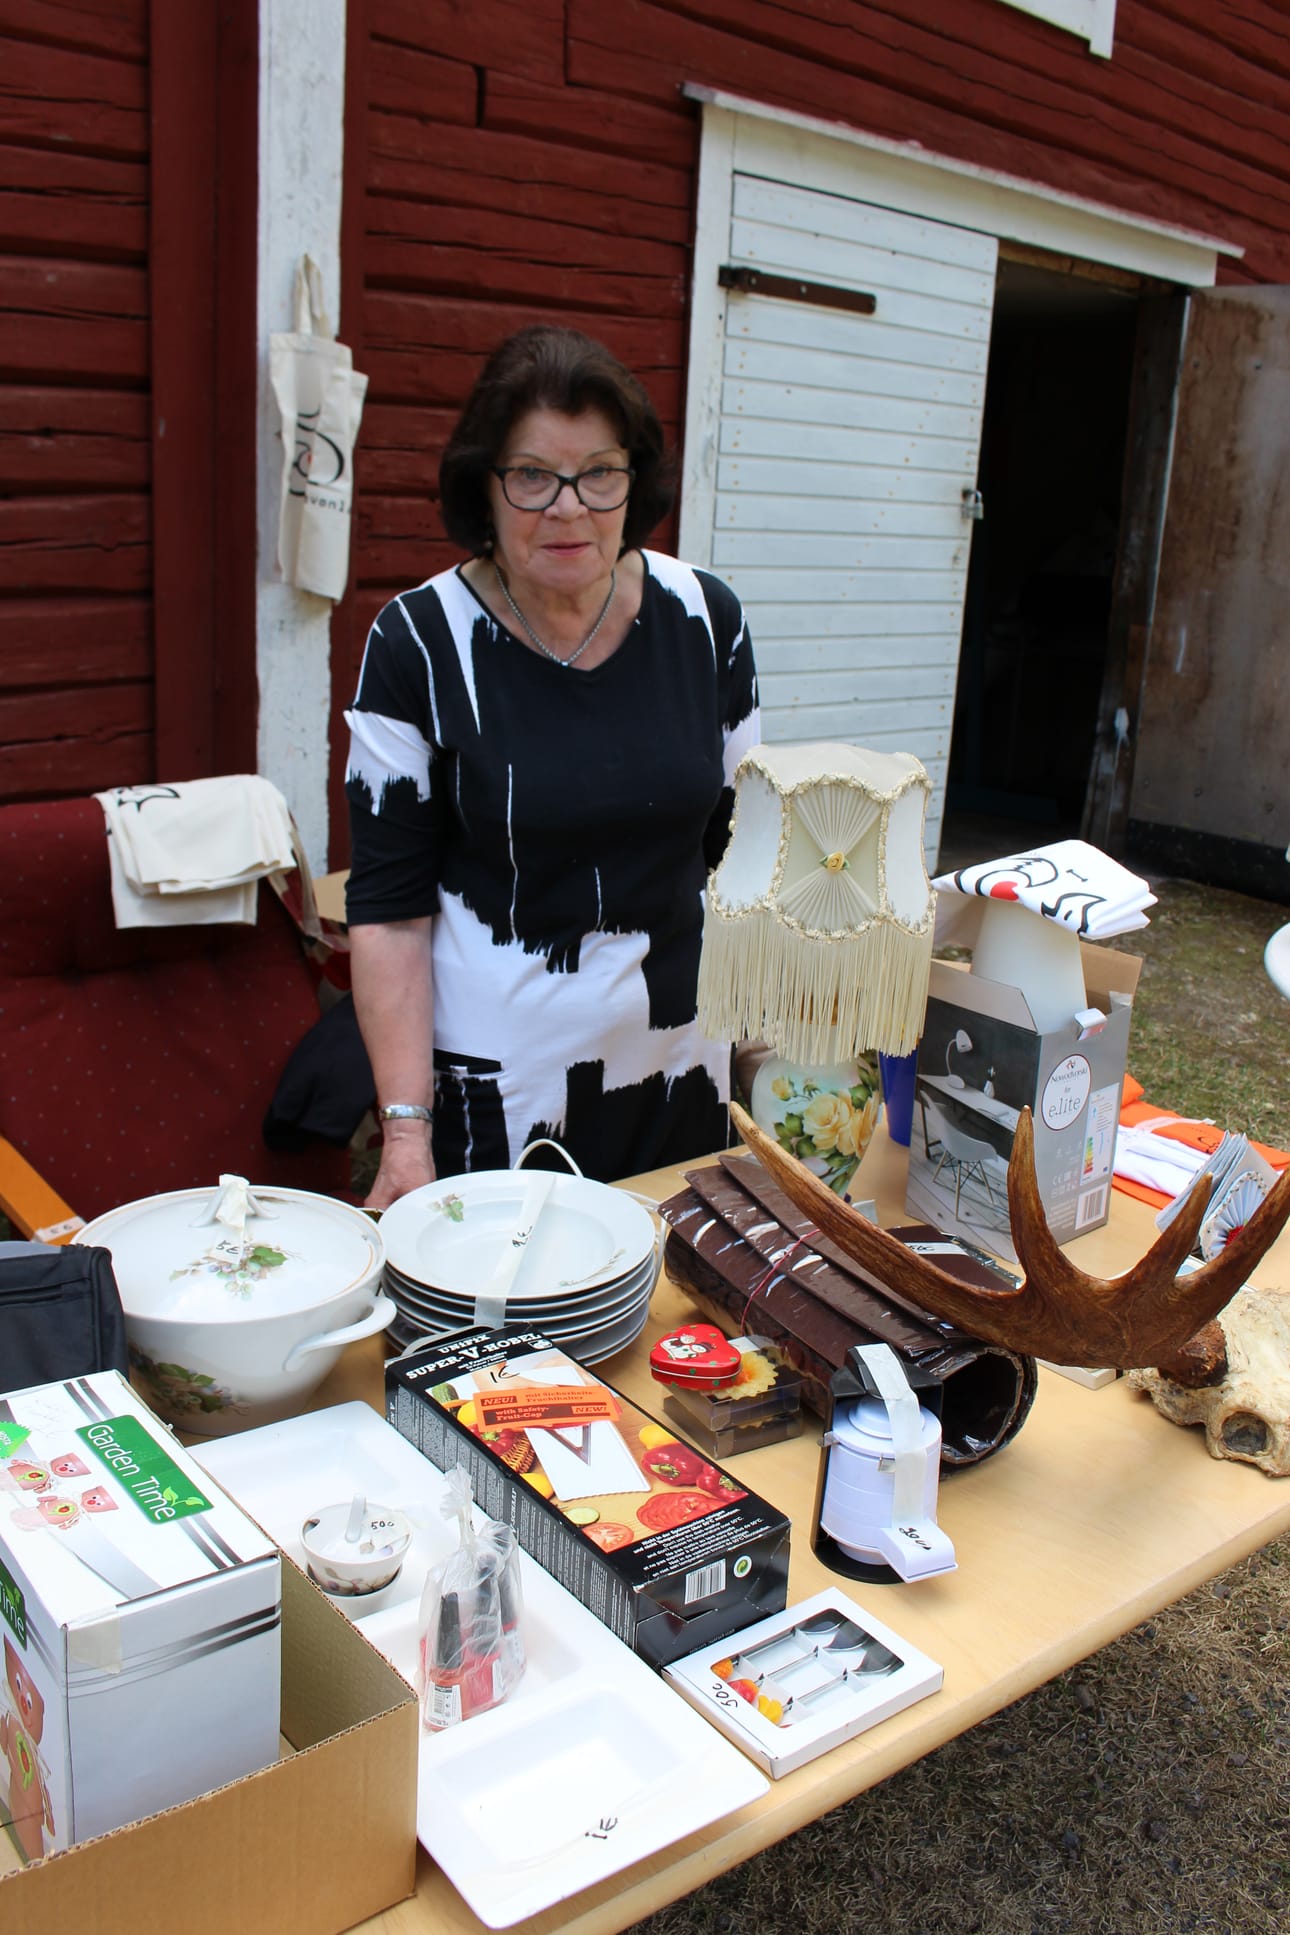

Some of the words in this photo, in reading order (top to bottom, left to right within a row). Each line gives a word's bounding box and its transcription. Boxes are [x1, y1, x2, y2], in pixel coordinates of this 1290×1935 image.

[405, 1332, 542, 1380] SUPER-V-HOBEL
[483, 1396, 513, 1406] NEU!
[495, 1408, 516, 1416] with
[87, 1424, 141, 1477] Garden
[131, 1476, 176, 1520] Time
